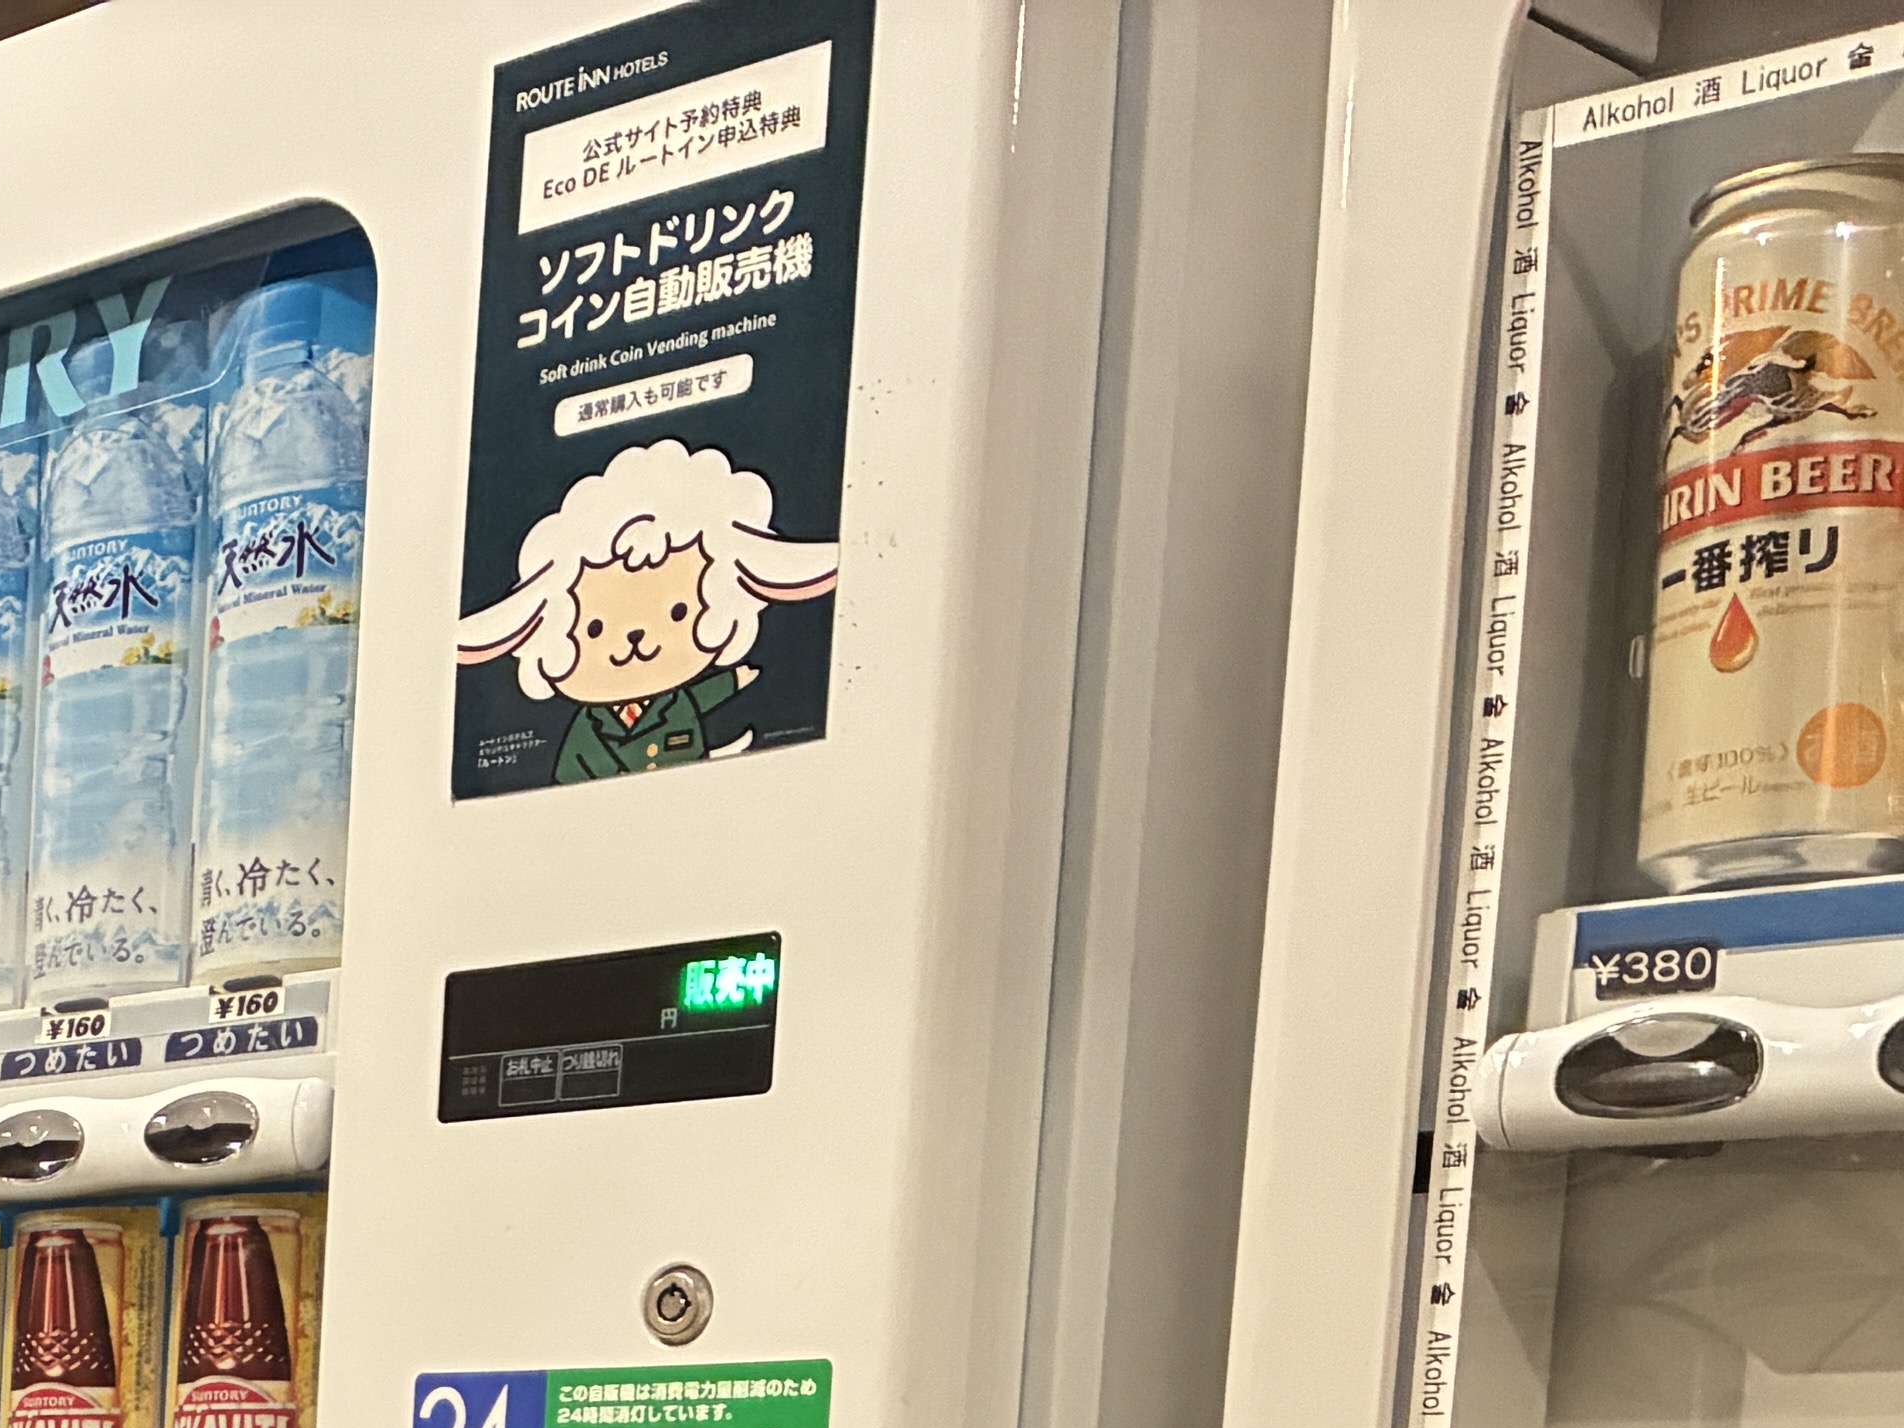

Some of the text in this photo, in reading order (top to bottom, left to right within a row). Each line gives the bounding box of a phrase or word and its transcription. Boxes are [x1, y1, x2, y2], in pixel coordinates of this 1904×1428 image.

[516, 78, 574, 112] ROUTE
[614, 51, 668, 82] HOTELS
[1583, 55, 1827, 132] Alkohol 酒 Liquor
[544, 108, 801, 199] Eco DE ルートイン申込特典
[583, 92, 762, 159] 公式サイト予約特典
[539, 191, 794, 295] ソフトドリンク
[517, 234, 812, 348] コイン自動販売機
[540, 312, 777, 385] Soft drink Coin Vending machine
[578, 368, 726, 422] 通常購入も可能です
[1762, 454, 1892, 500] BEER
[218, 521, 335, 595] 天然水
[1462, 140, 1543, 969] Alkohol 酒 Liquor Alkohol 酒 Liquor Alkohol Liquor
[1662, 526, 1838, 592] 一番搾り
[684, 952, 775, 1006] 販売中
[1592, 946, 1712, 985] ¥380
[661, 1008, 677, 1029] 円
